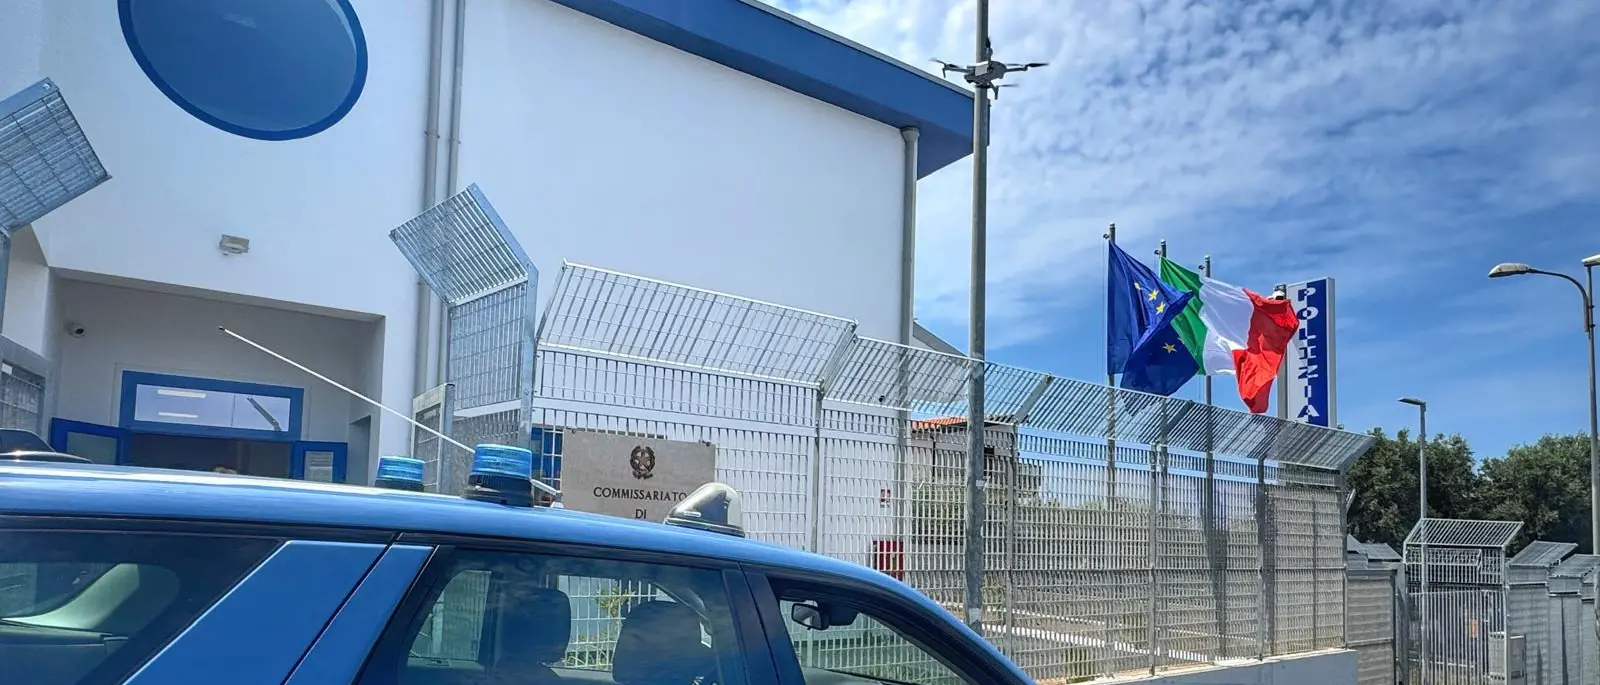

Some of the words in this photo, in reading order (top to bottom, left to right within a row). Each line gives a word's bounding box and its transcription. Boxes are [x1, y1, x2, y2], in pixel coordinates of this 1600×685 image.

[1297, 287, 1320, 418] POLIZIA
[593, 486, 688, 502] COMMISSARIATO
[634, 508, 647, 520] DI
